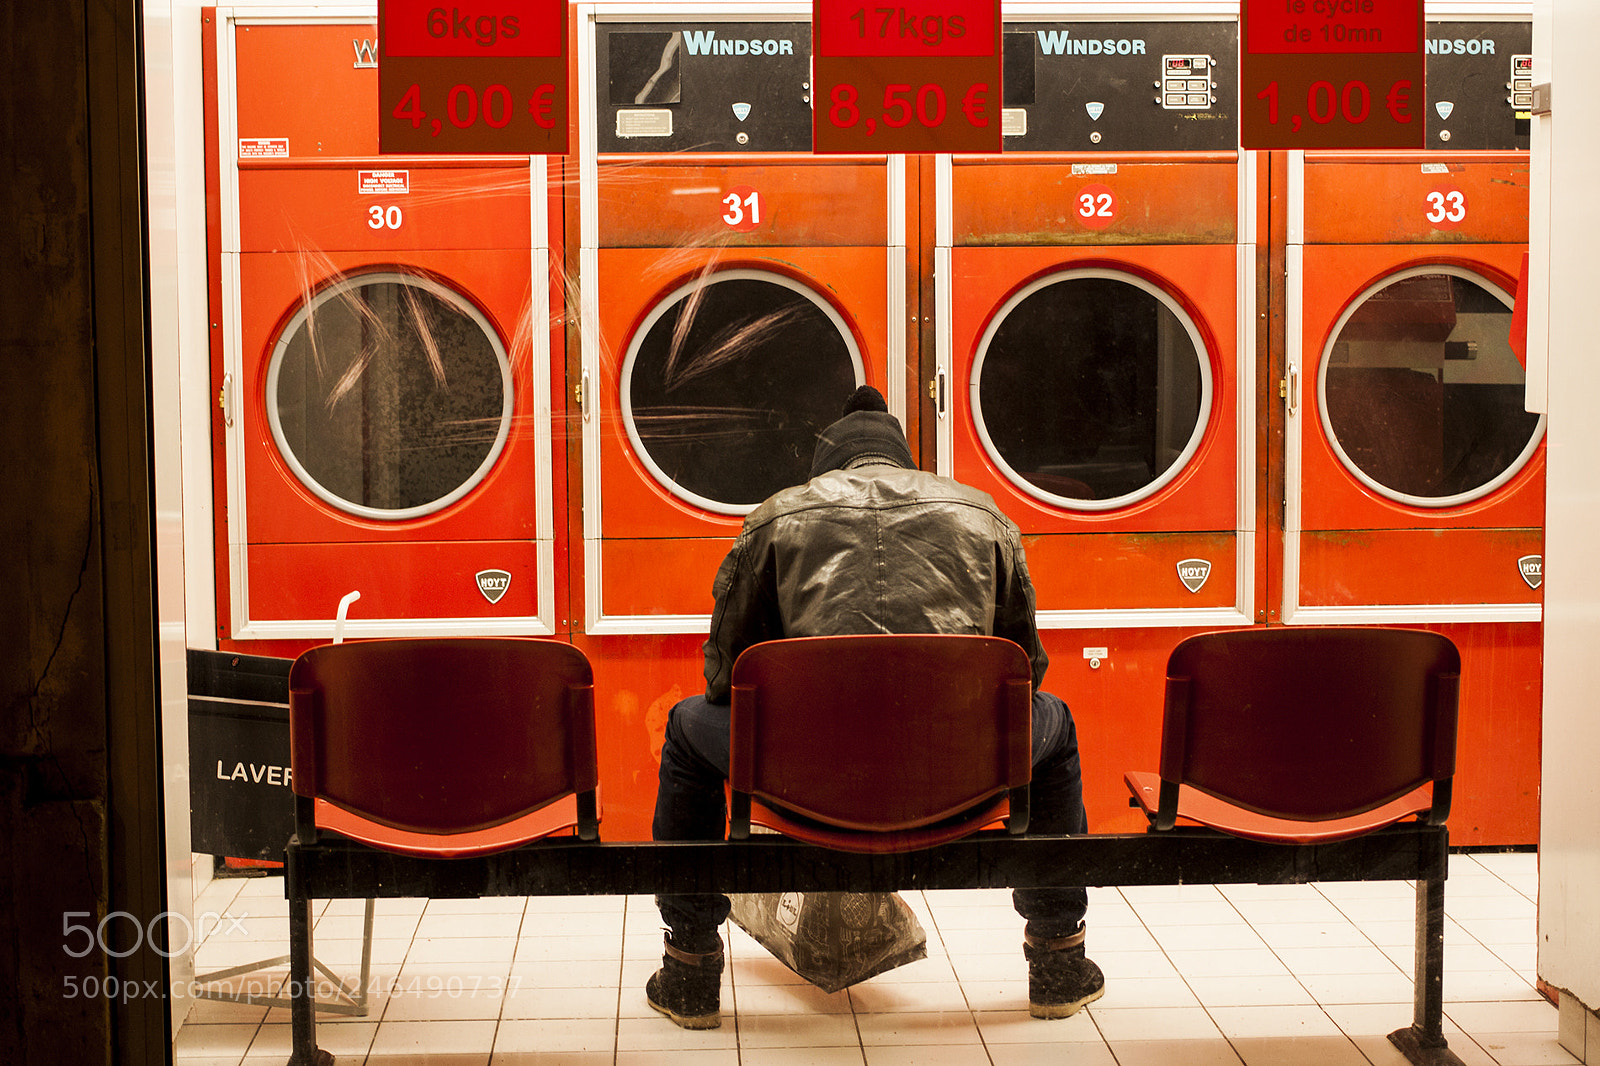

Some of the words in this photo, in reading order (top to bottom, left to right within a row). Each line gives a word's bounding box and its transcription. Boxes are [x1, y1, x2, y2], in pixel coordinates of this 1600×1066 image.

[1286, 0, 1305, 13] le
[1313, 0, 1373, 18] cycle
[427, 8, 520, 46] 6kgs
[851, 8, 966, 46] 17kgs
[1284, 24, 1311, 42] de
[1320, 24, 1382, 42] 10mn
[392, 83, 513, 137] 4,00
[528, 83, 556, 129] €
[828, 83, 947, 137] 8,50
[961, 83, 989, 128] €
[1256, 80, 1371, 133] 1,00
[1385, 79, 1412, 124] €
[368, 205, 402, 229] 30
[722, 191, 760, 225] 31
[1079, 193, 1113, 217] 32
[1426, 190, 1466, 223] 33
[480, 577, 507, 588] HOYT
[1181, 567, 1207, 577] HOYT
